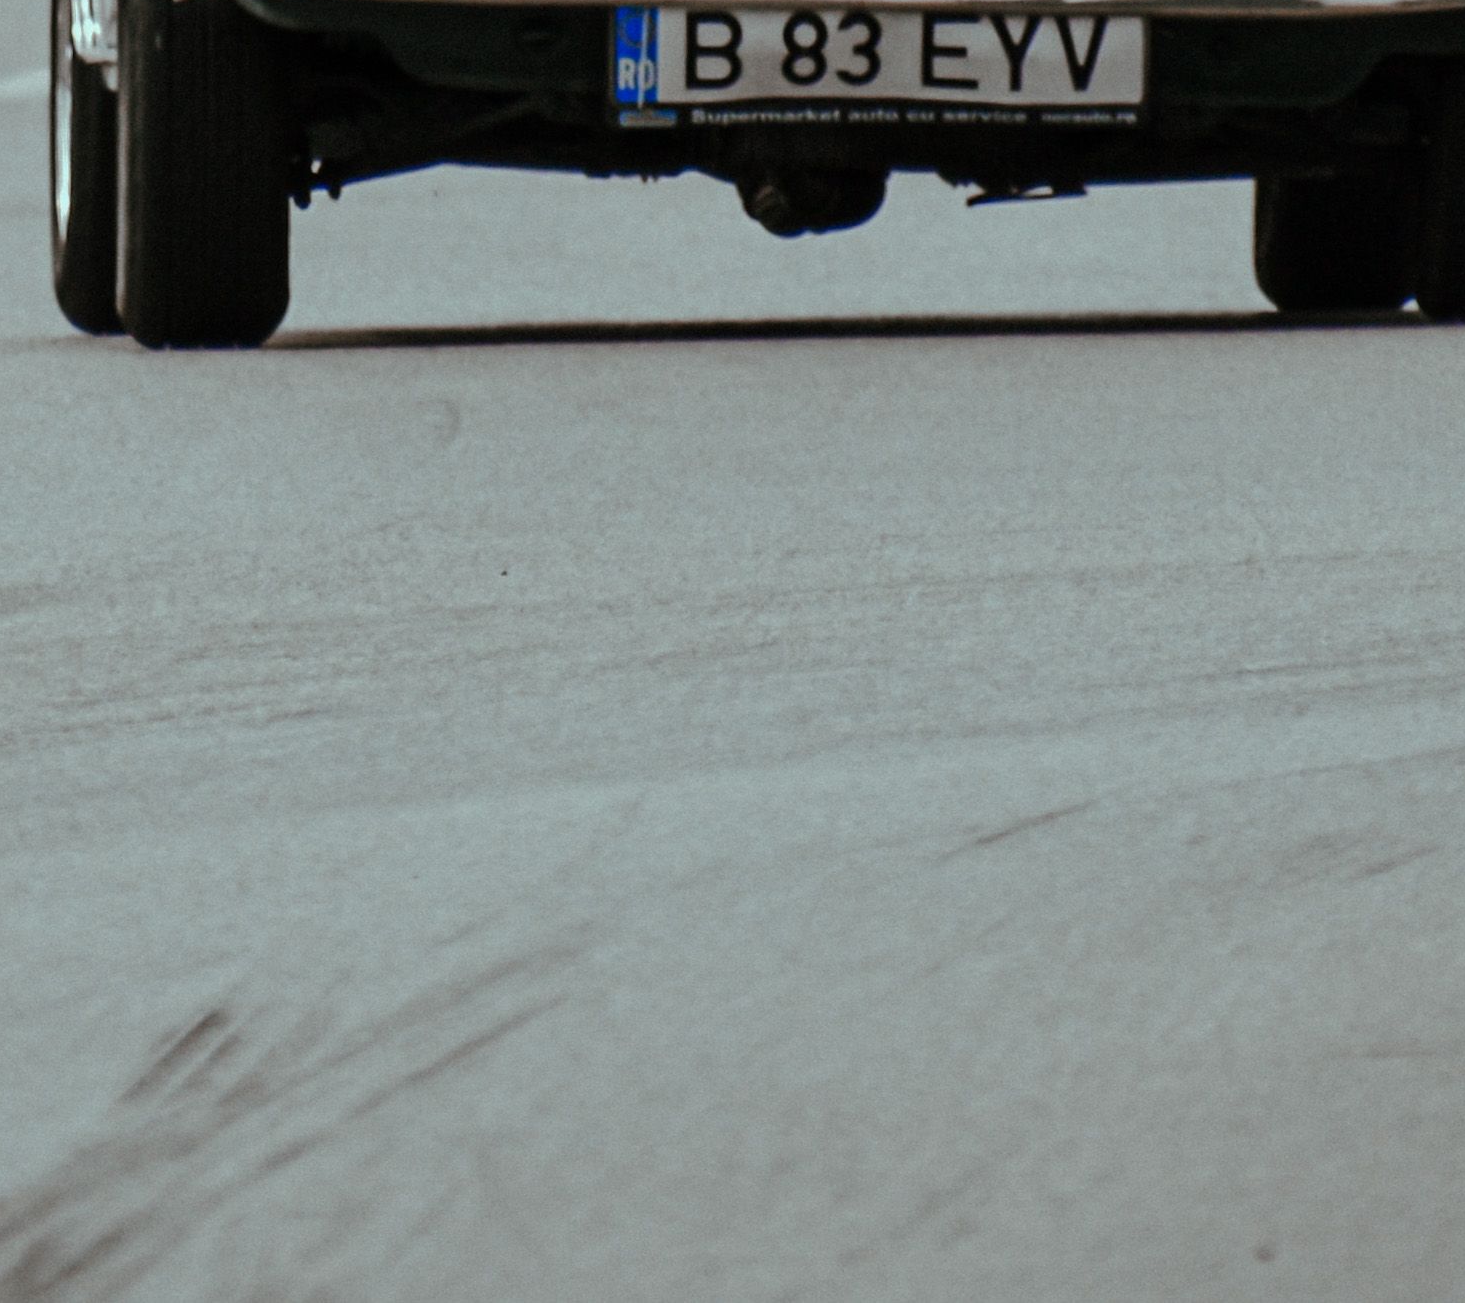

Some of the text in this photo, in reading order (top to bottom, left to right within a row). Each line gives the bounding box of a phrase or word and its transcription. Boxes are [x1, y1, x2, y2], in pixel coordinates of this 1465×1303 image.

[685, 10, 1110, 92] B 83 EYV
[618, 57, 656, 90] RO
[690, 107, 841, 125] Supermarket
[847, 108, 899, 124] auto
